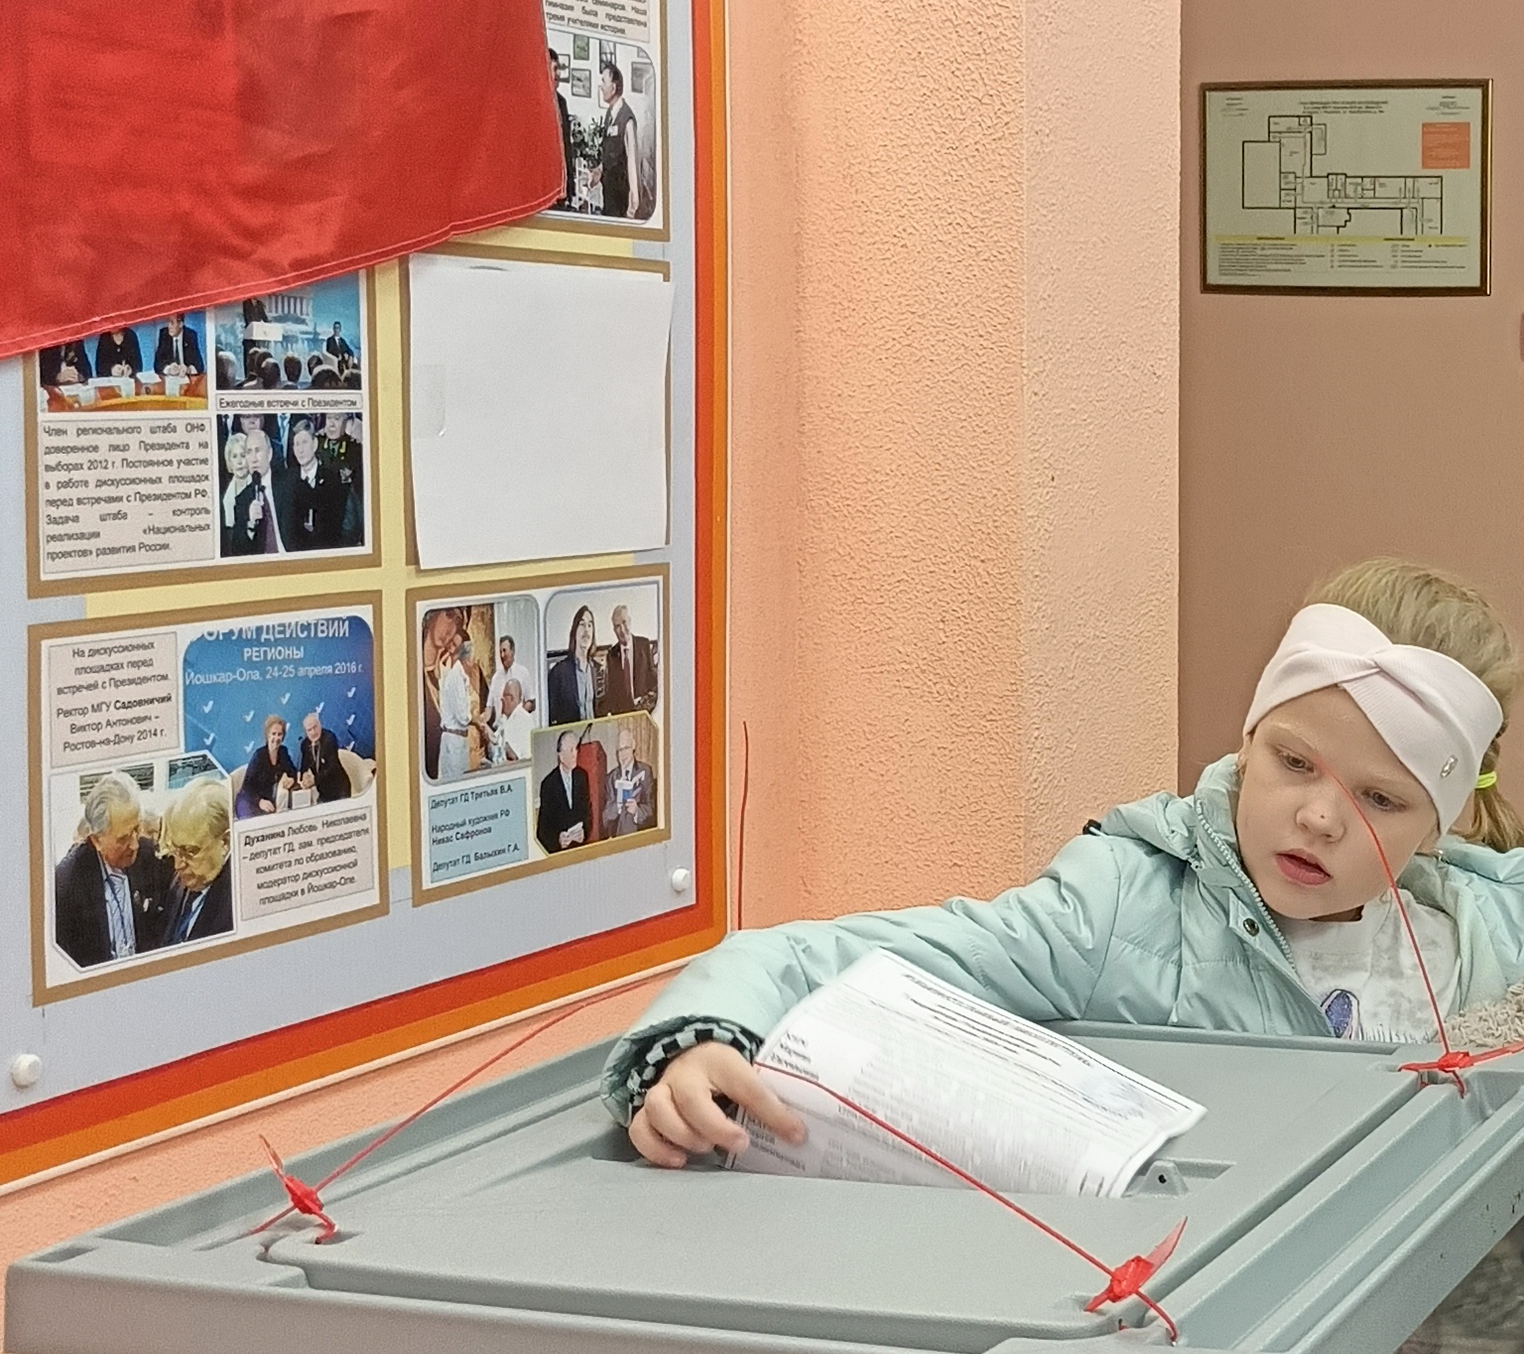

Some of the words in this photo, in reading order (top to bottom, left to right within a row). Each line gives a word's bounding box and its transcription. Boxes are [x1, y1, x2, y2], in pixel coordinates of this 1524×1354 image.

[220, 398, 264, 408] Ежегодные
[267, 400, 299, 408] встречи
[308, 398, 356, 408] Президентом
[43, 426, 68, 438] Член
[76, 426, 142, 438] регионального
[150, 423, 177, 435] штаба
[44, 444, 99, 456] доверенное
[108, 443, 130, 453] лицо
[139, 440, 190, 453] Президента
[198, 441, 209, 449] на
[44, 461, 84, 473] выборах
[87, 459, 109, 470] 2012
[121, 458, 173, 469] Постоянное
[176, 457, 209, 469] участие
[45, 482, 50, 490] в
[57, 479, 89, 491] работе
[168, 474, 209, 484] площадок
[45, 498, 74, 510] перед
[77, 496, 123, 507] встречами
[134, 491, 192, 504] Президентом
[46, 513, 80, 526] Задача
[99, 510, 128, 521] штаба
[172, 507, 211, 517] контроль
[46, 531, 101, 544] реализации
[96, 544, 136, 557] развития
[261, 617, 350, 642] ДЕЙСТВИЙ
[72, 648, 85, 658] На
[243, 646, 304, 661] РЕГИОНЫ
[74, 663, 124, 676] площадках
[127, 658, 153, 670] перед
[266, 665, 296, 679] 24-25
[297, 665, 333, 678] апреля
[334, 661, 357, 674] 2016
[57, 680, 99, 695] встречей
[101, 681, 107, 689] с
[57, 706, 89, 718] Ректор
[91, 701, 112, 713] МГУ
[114, 693, 172, 710] Садовничий
[70, 721, 103, 734] Виктор
[105, 714, 152, 729] Антонович
[63, 734, 135, 752] Ростов-на-Дону
[137, 728, 158, 741] 2014
[160, 729, 167, 737] г.
[430, 796, 458, 809] Депутат
[460, 793, 469, 802] ГД
[471, 789, 498, 801] Третьяк
[500, 809, 510, 818] РФ
[244, 830, 285, 847] Духанина
[287, 824, 318, 837] Любовь
[321, 813, 367, 828] Николаевна
[455, 826, 492, 840] Сафронов
[249, 846, 282, 861] депутат
[256, 860, 292, 874] комитета
[294, 857, 304, 865] по
[433, 859, 460, 873] Депутат
[462, 854, 471, 864] ГД
[257, 873, 300, 889] модератор
[259, 889, 299, 905] площадки
